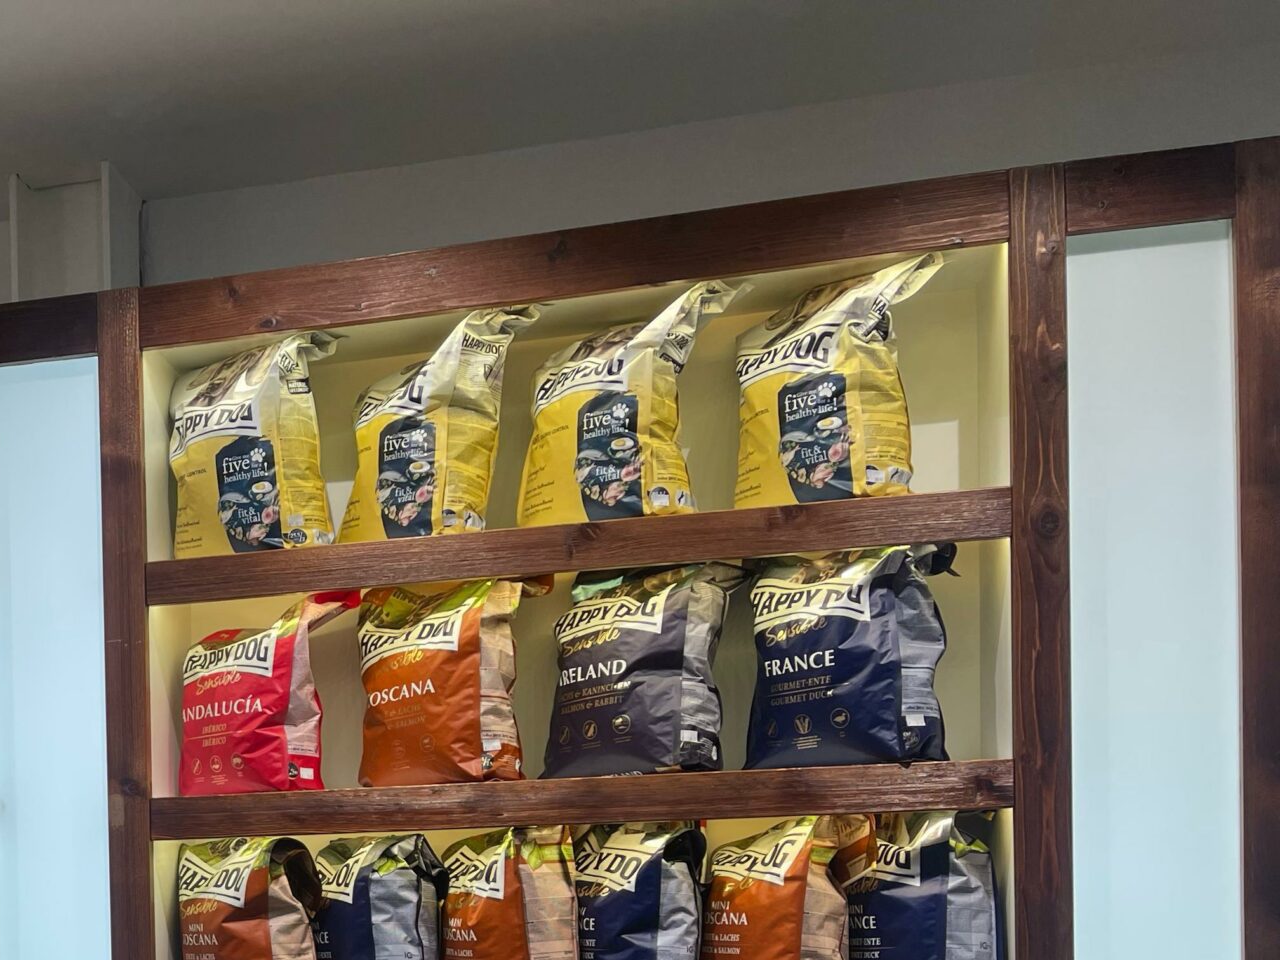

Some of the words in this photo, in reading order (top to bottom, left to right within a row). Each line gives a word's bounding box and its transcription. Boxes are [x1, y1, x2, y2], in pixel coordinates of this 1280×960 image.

[783, 331, 835, 363] DOG
[784, 392, 816, 413] five
[583, 412, 611, 431] five
[786, 407, 817, 422] healthy
[583, 427, 613, 440] healthy
[384, 435, 409, 451] five
[384, 450, 411, 462] healthy
[805, 451, 828, 465] vital
[222, 458, 250, 475] five
[224, 471, 252, 483] healthy
[599, 471, 620, 483] vital
[397, 491, 415, 503] vital
[242, 512, 261, 524] vital
[752, 589, 820, 617] HAPPY
[555, 606, 613, 635] HAPPY
[234, 632, 269, 662] DOG
[764, 649, 835, 677] FRANCE
[559, 659, 627, 687] IRELAND
[196, 670, 241, 695] Sensible
[182, 695, 263, 723] ANDALUCÍA
[216, 863, 251, 892] DOG
[705, 912, 748, 925] OSCANA
[850, 916, 876, 929] ANCE
